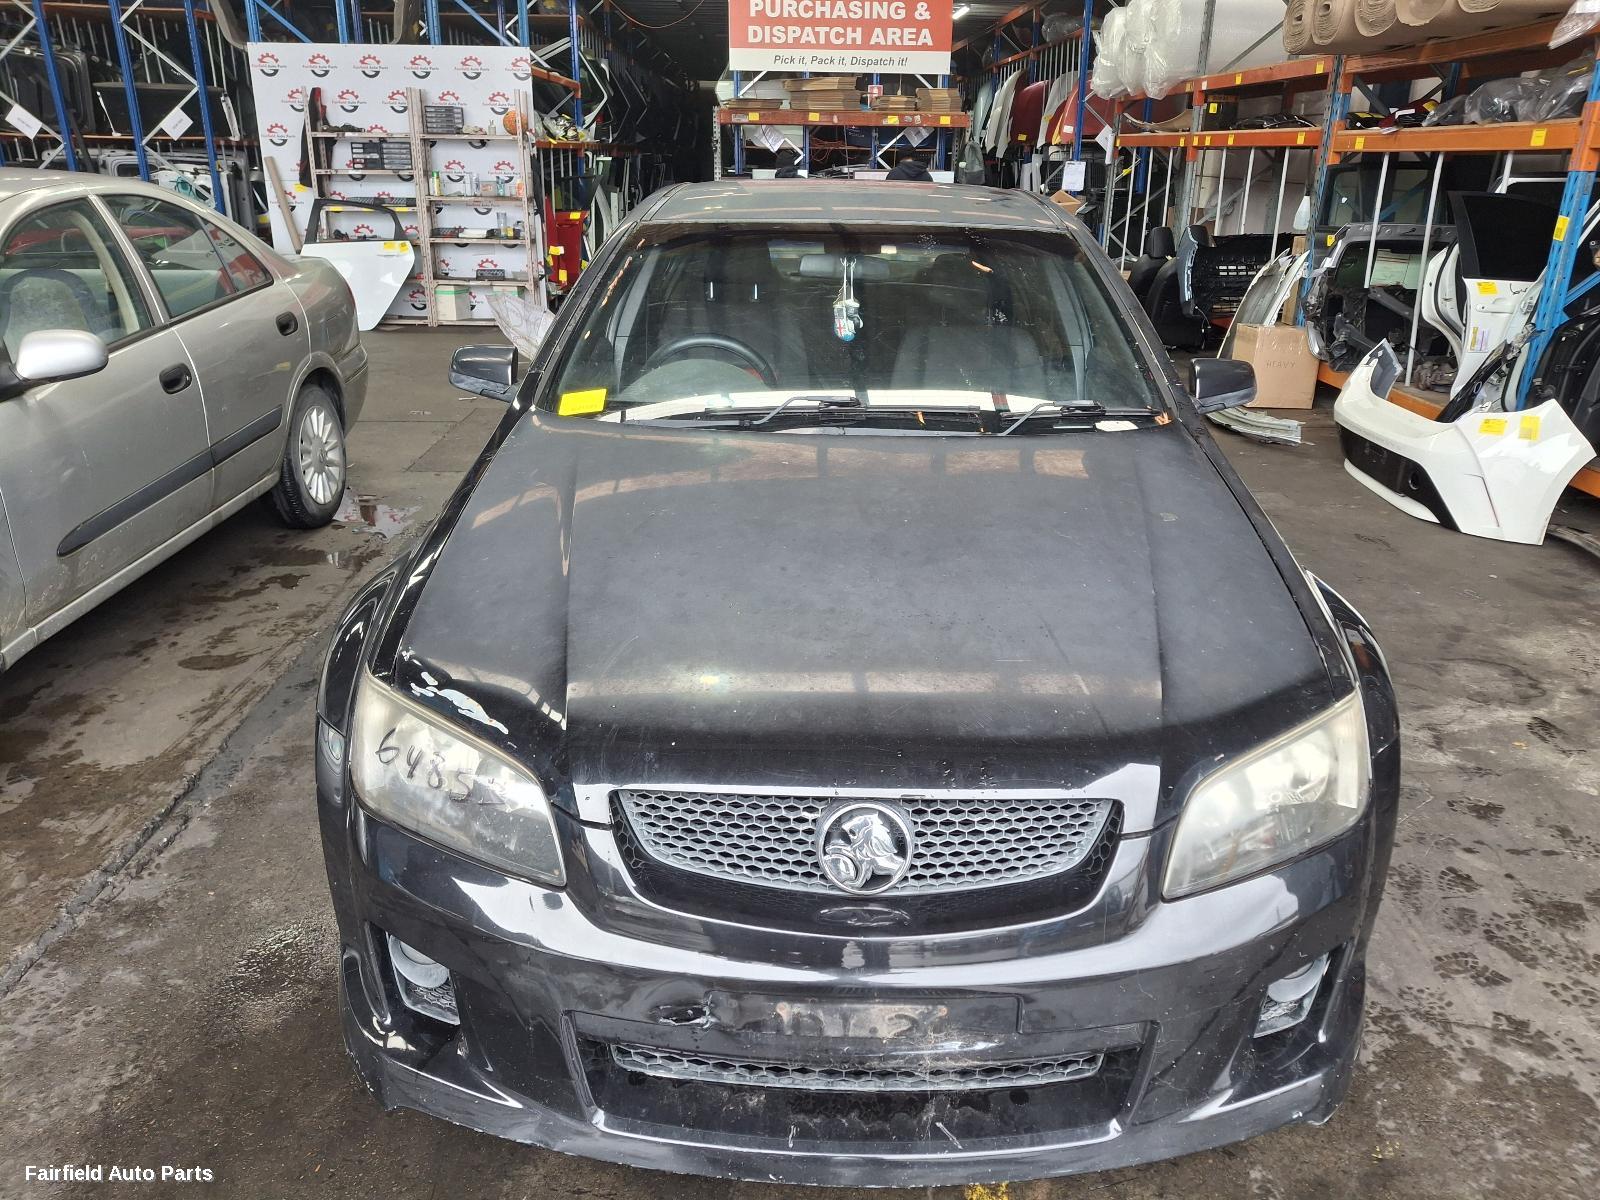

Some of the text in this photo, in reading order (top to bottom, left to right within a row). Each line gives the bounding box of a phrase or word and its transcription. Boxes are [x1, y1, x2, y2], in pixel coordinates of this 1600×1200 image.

[749, 0, 931, 20] PURCHASING &
[747, 25, 934, 46] DISPATCH AREA
[773, 55, 908, 69] Pick it, Pack it, Dispatch it!
[1266, 360, 1296, 369] HEAVY
[375, 727, 472, 803] 6485
